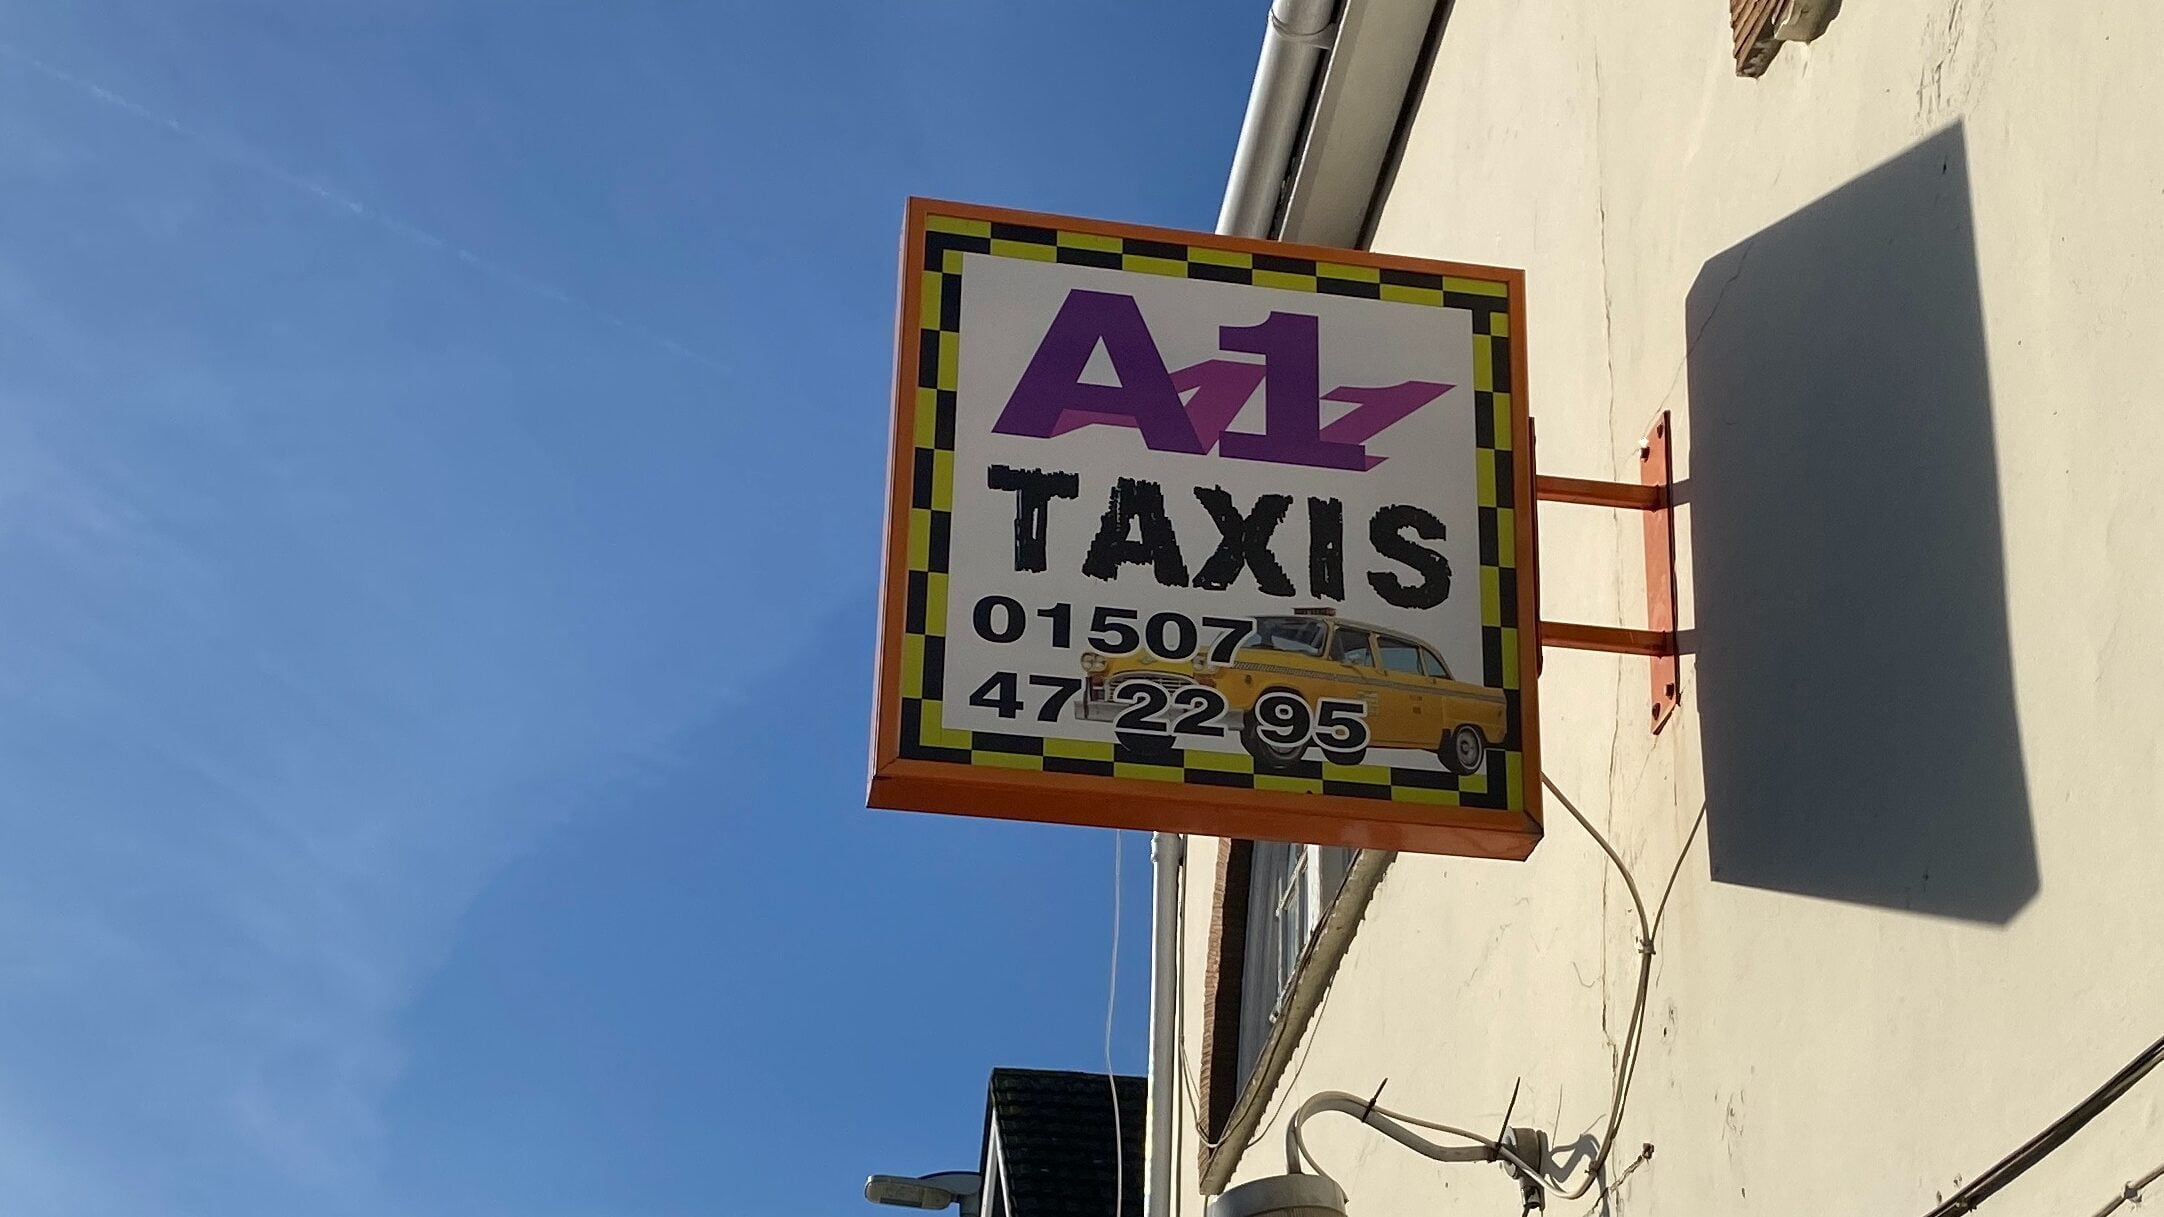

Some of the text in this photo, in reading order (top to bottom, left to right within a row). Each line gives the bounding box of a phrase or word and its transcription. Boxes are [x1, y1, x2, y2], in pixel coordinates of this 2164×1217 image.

[991, 288, 1380, 472] A1
[987, 464, 1452, 610] TAXIS
[972, 595, 1253, 664] 01507
[969, 671, 1082, 723] 47
[1115, 685, 1226, 737] 22
[1257, 695, 1369, 749] 95
